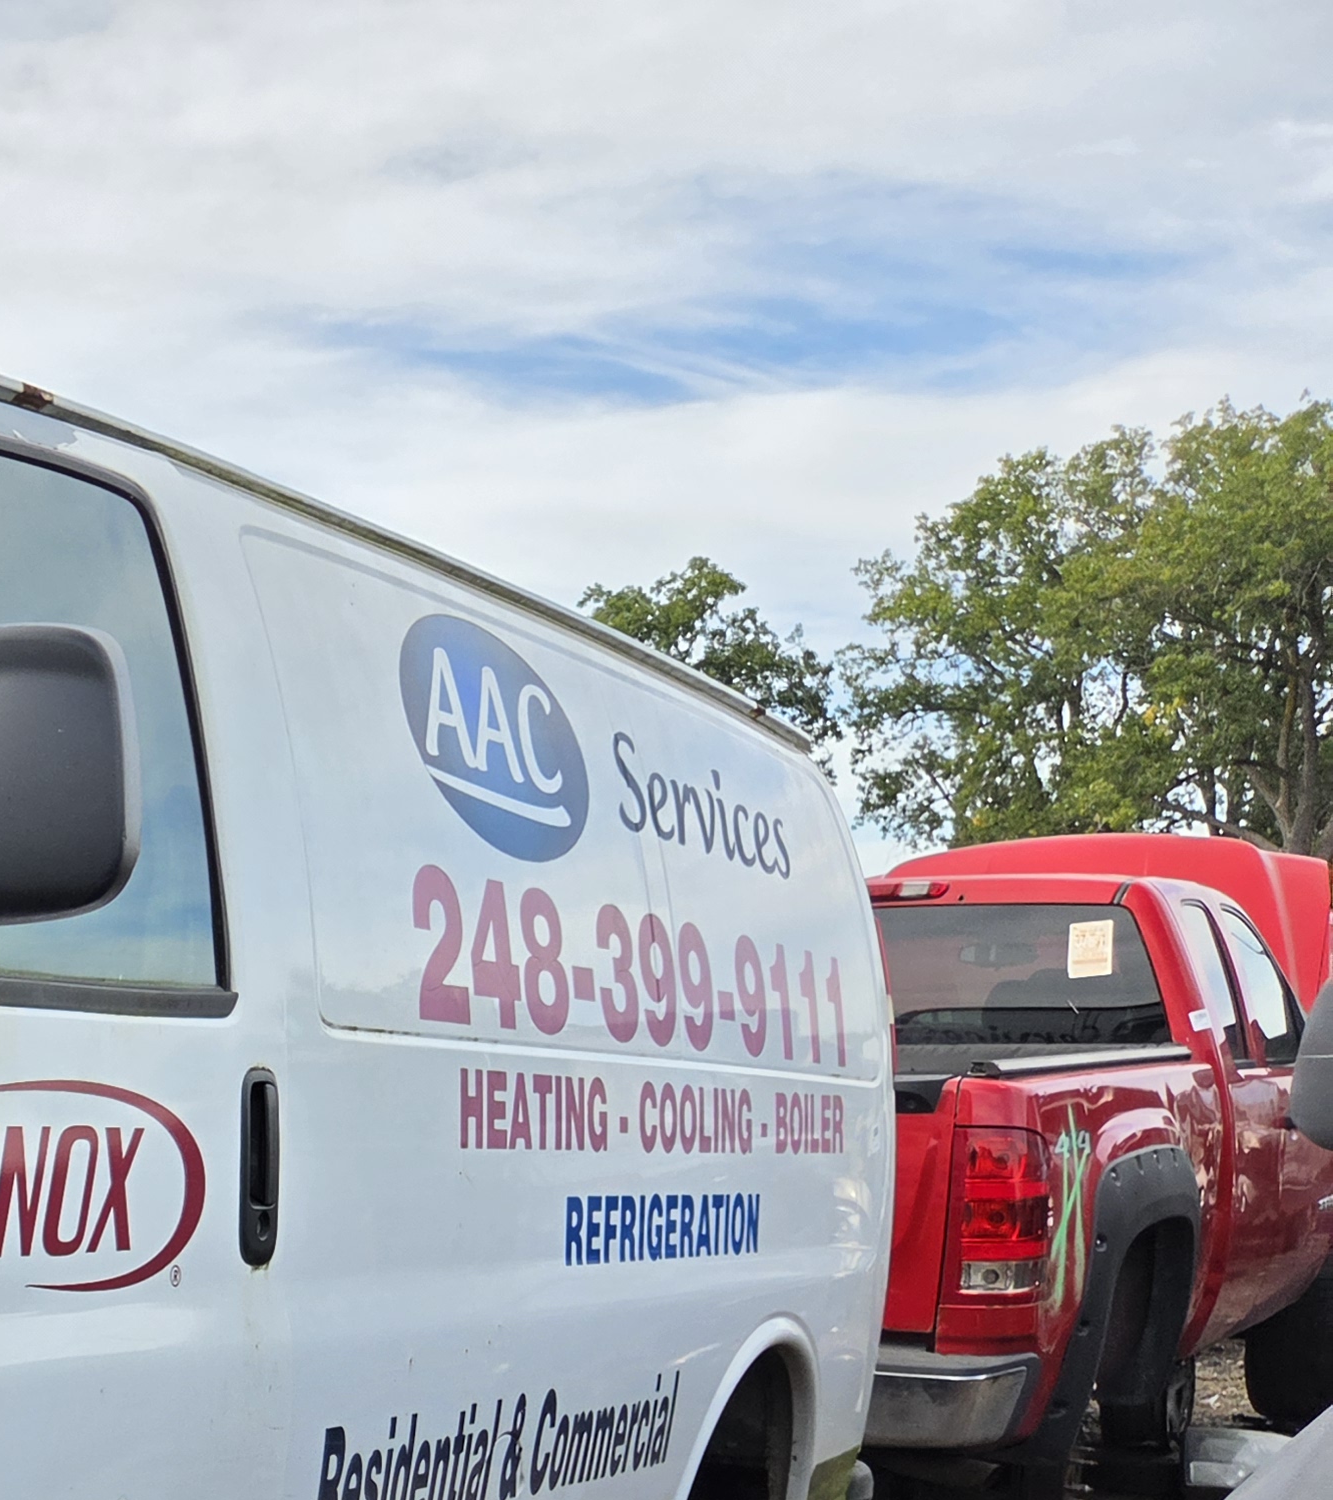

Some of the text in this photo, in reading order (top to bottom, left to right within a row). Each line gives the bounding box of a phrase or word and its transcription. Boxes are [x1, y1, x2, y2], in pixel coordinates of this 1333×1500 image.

[424, 646, 792, 880] AAC Services
[412, 863, 848, 1068] 248-399-9111
[459, 1067, 608, 1153] HEATING
[639, 1080, 753, 1155] COOLING
[774, 1091, 845, 1155] BOILER
[564, 1193, 761, 1267] REFRIGERATION
[530, 1370, 681, 1496] Commercial
